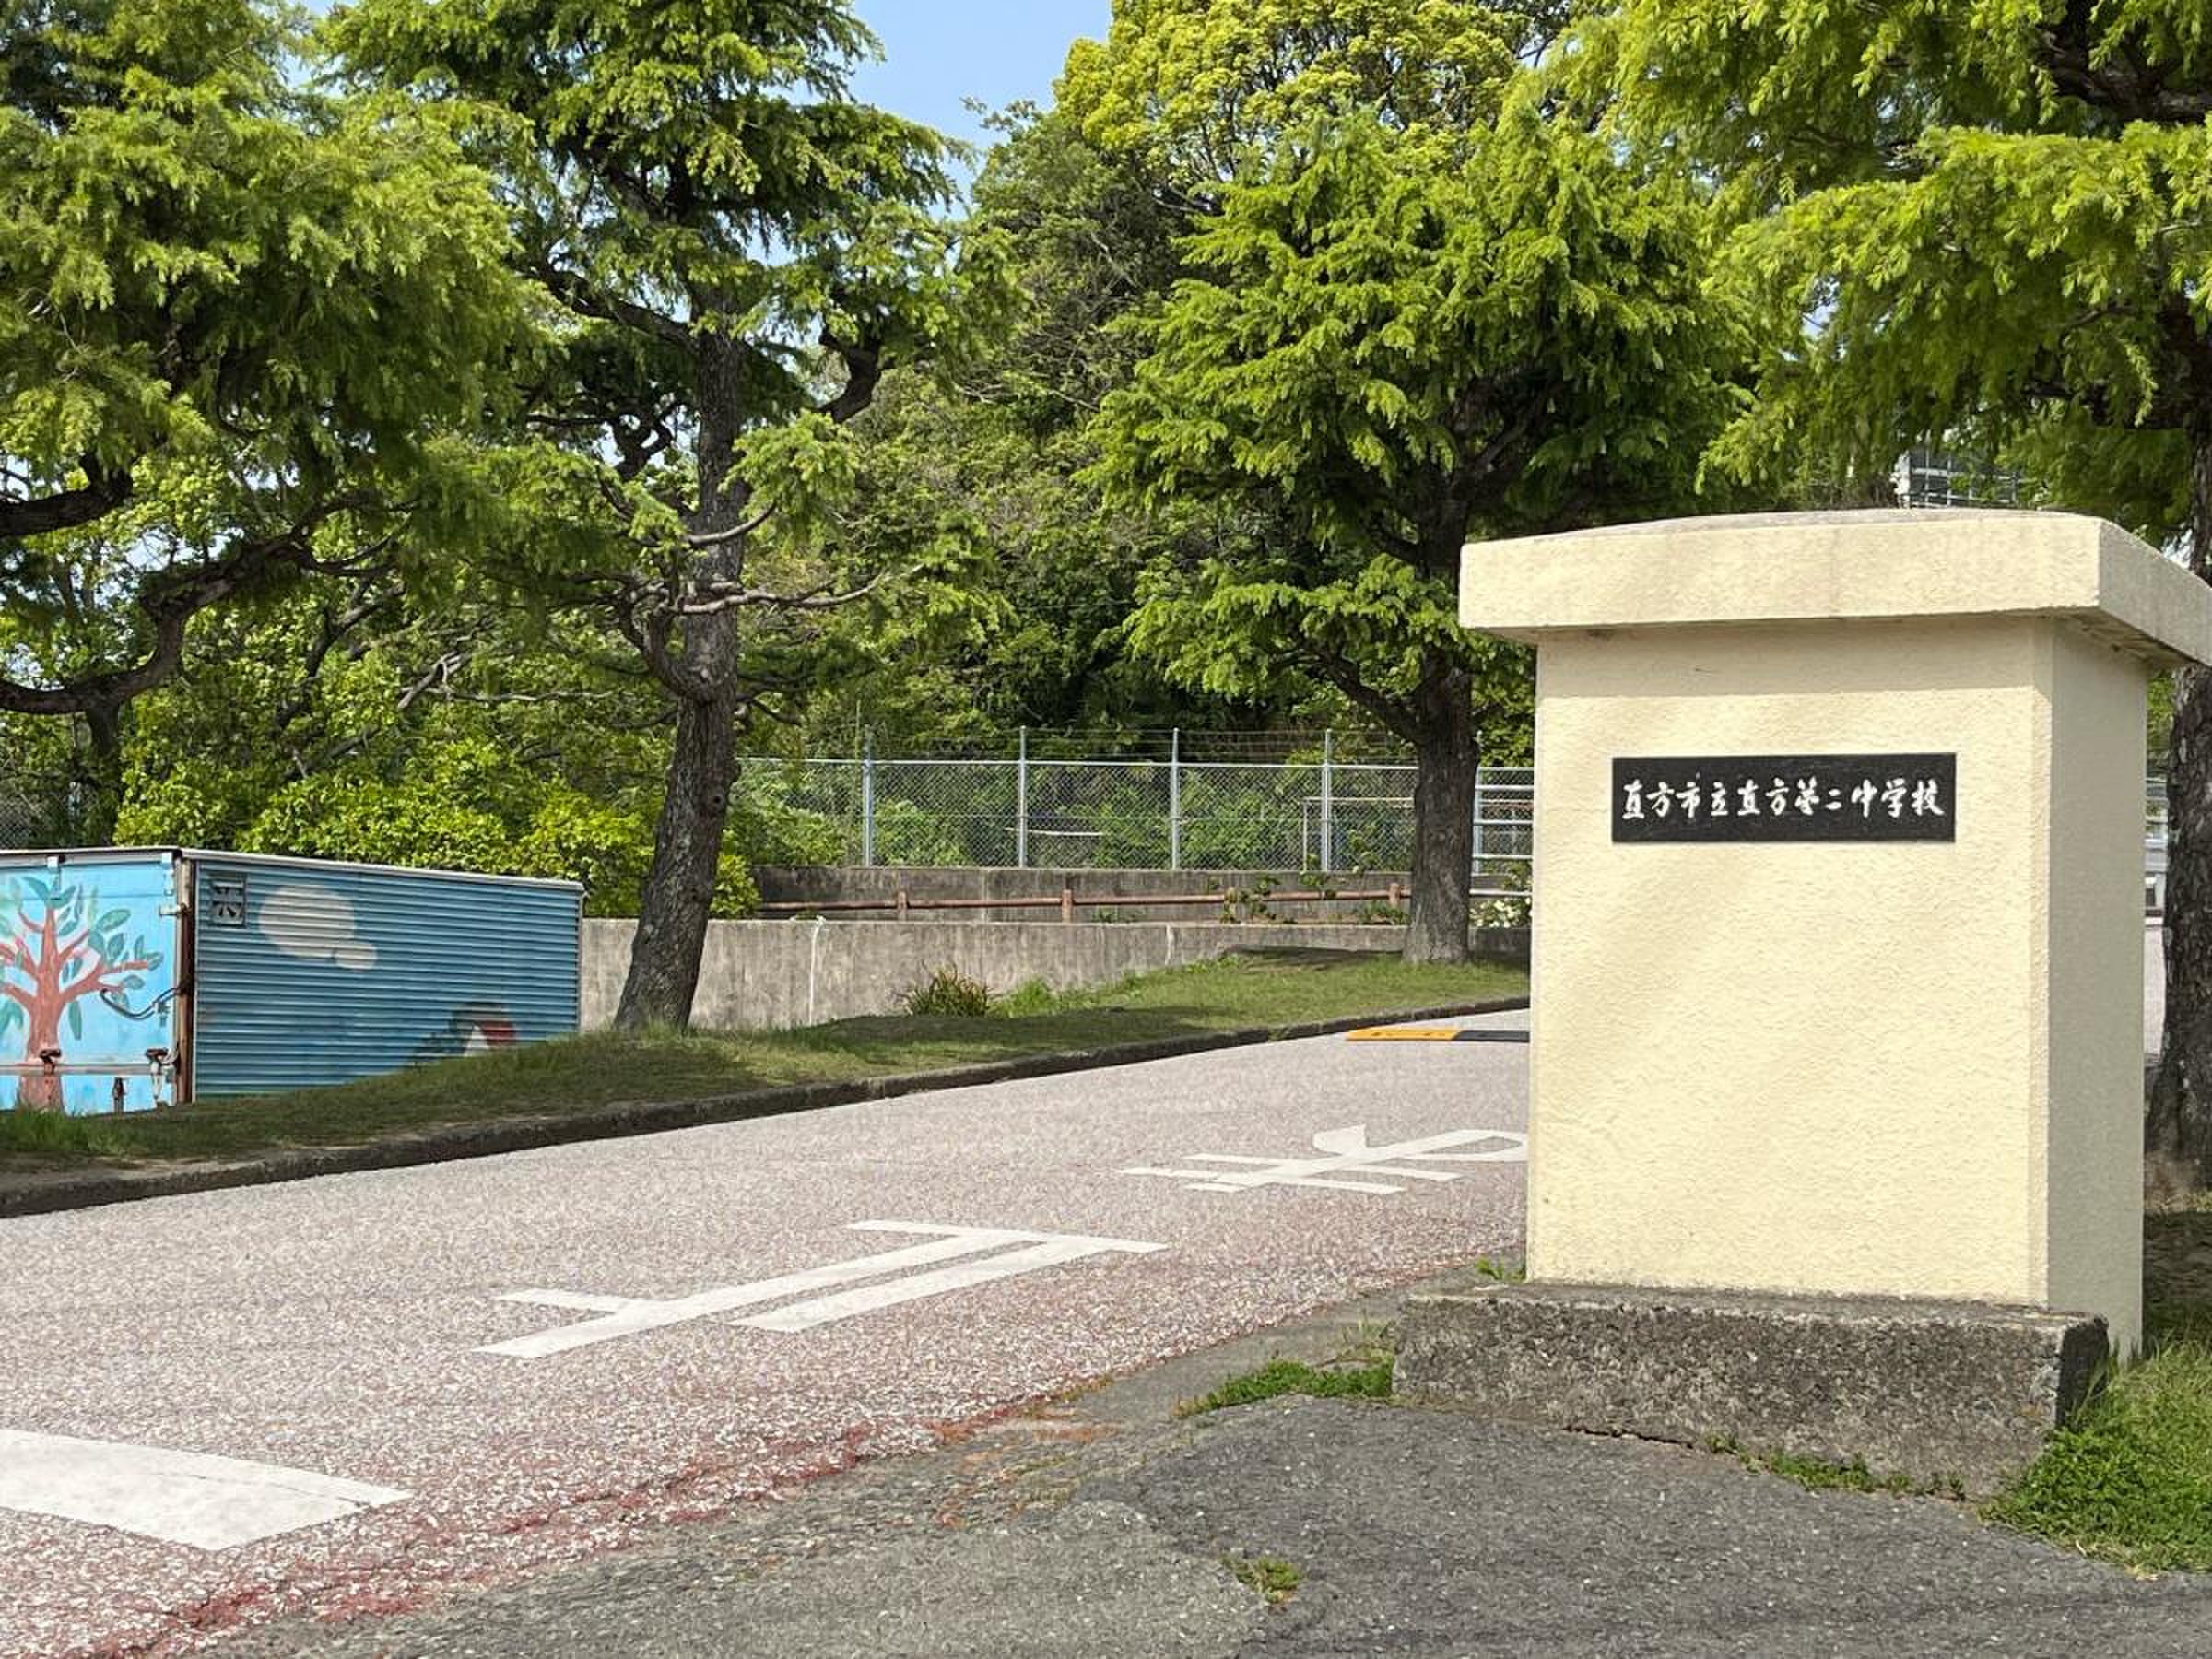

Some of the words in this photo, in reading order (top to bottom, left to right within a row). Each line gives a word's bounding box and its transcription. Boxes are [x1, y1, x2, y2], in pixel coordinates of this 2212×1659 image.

[1622, 776, 1945, 819] 直方市立直方第二中学校
